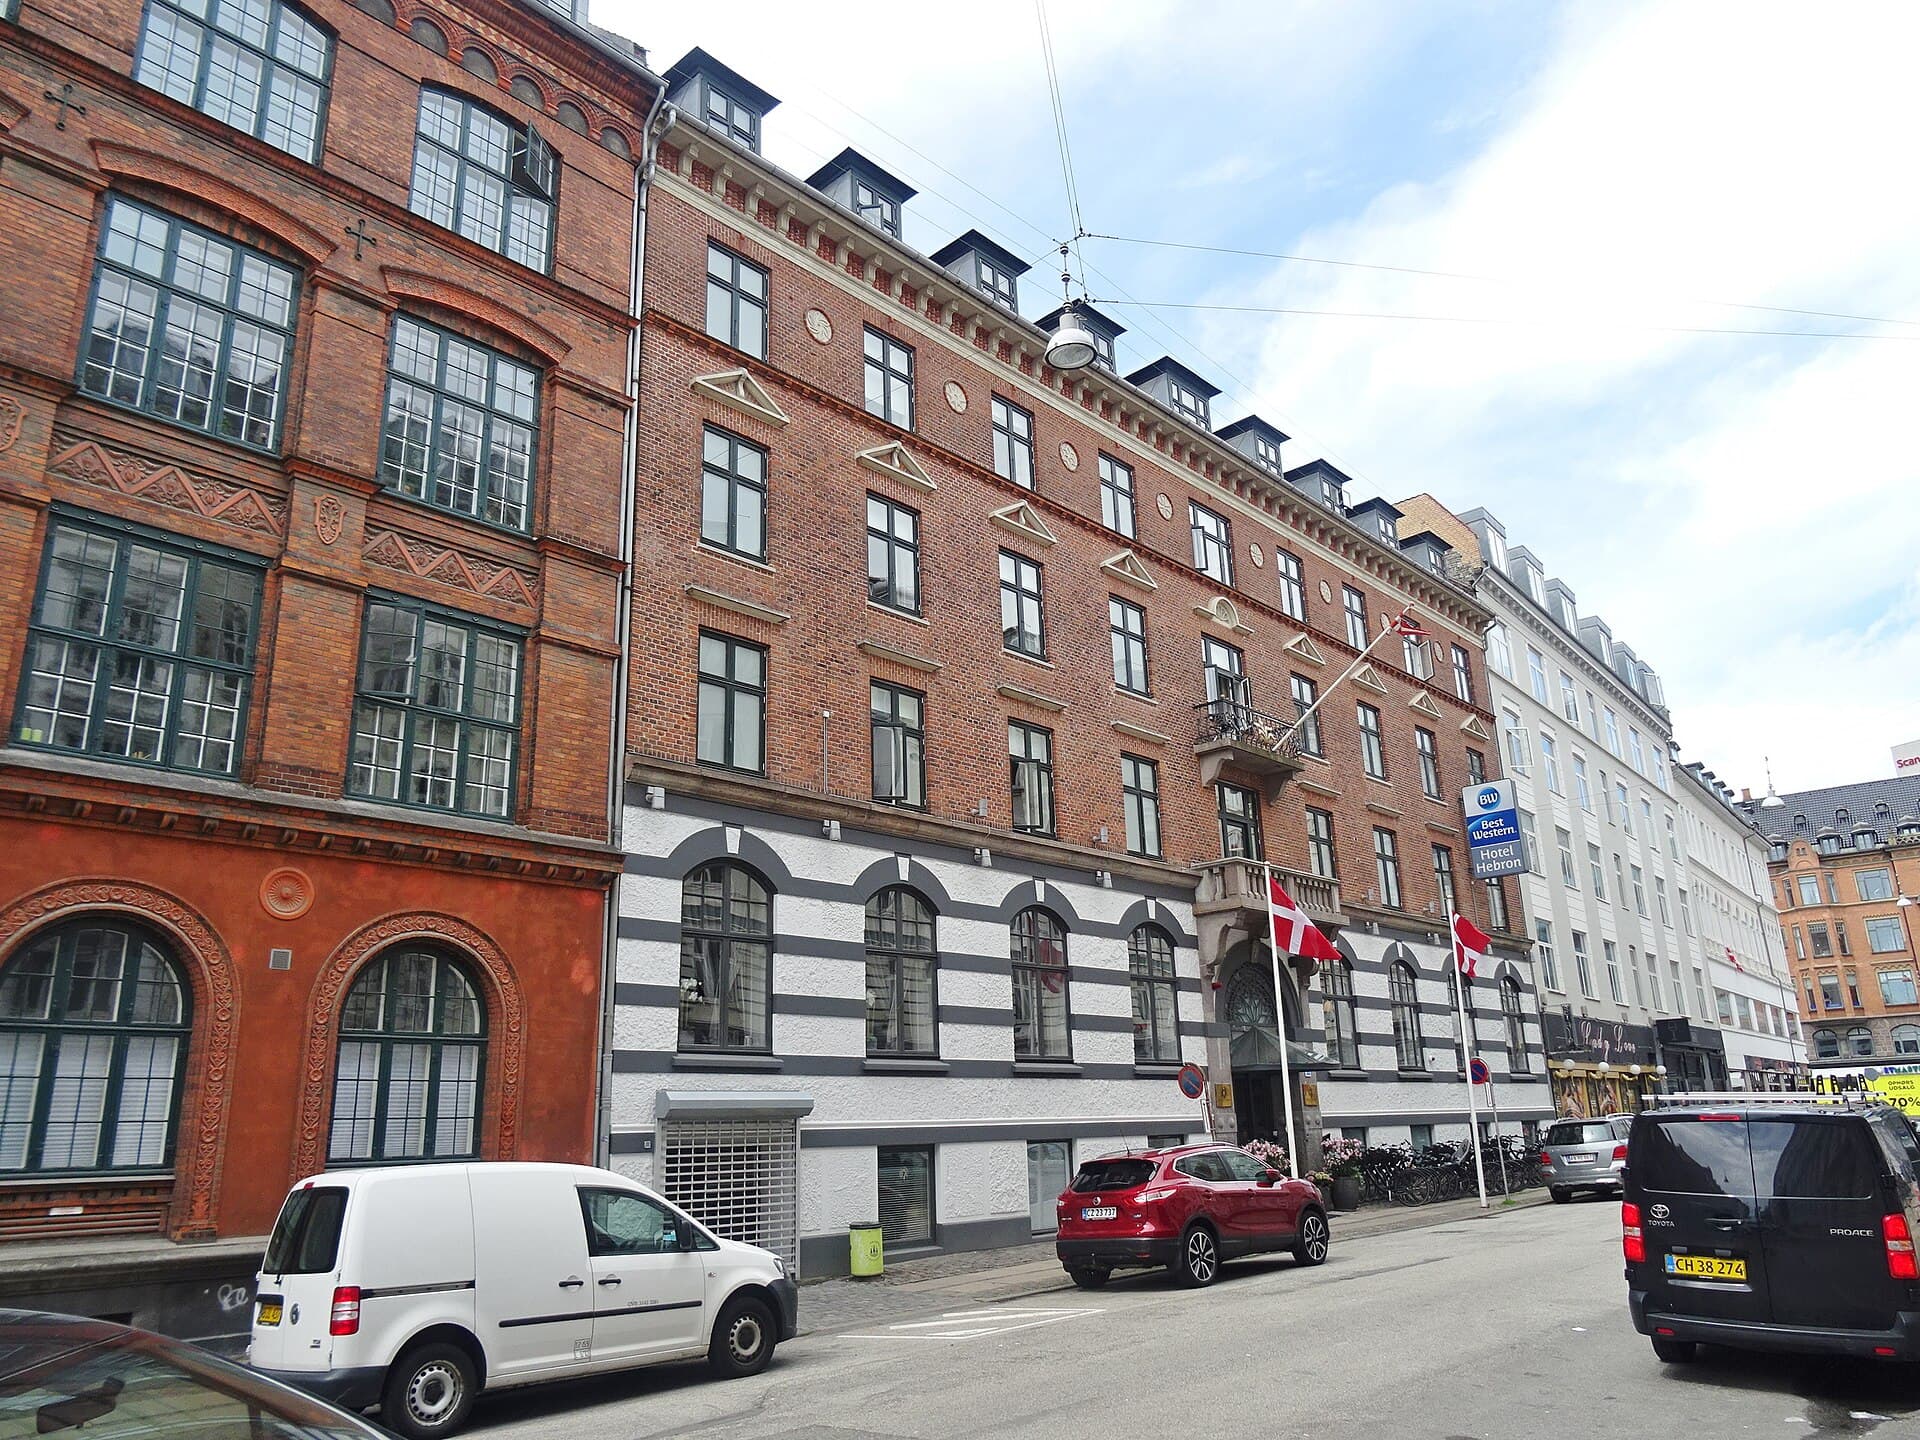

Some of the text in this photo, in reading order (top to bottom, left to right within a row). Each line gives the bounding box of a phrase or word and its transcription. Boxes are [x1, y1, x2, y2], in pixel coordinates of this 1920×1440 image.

[1479, 792, 1498, 806] BW
[1481, 817, 1504, 830] Best
[1472, 826, 1514, 841] Western
[1480, 844, 1514, 860] Hotel
[1476, 858, 1522, 874] Hebron
[1888, 1096, 1920, 1108] 70%
[1647, 1220, 1675, 1228] TOYOTA
[1829, 1228, 1875, 1237] PROACE
[1675, 1258, 1745, 1276] CH 38 274
